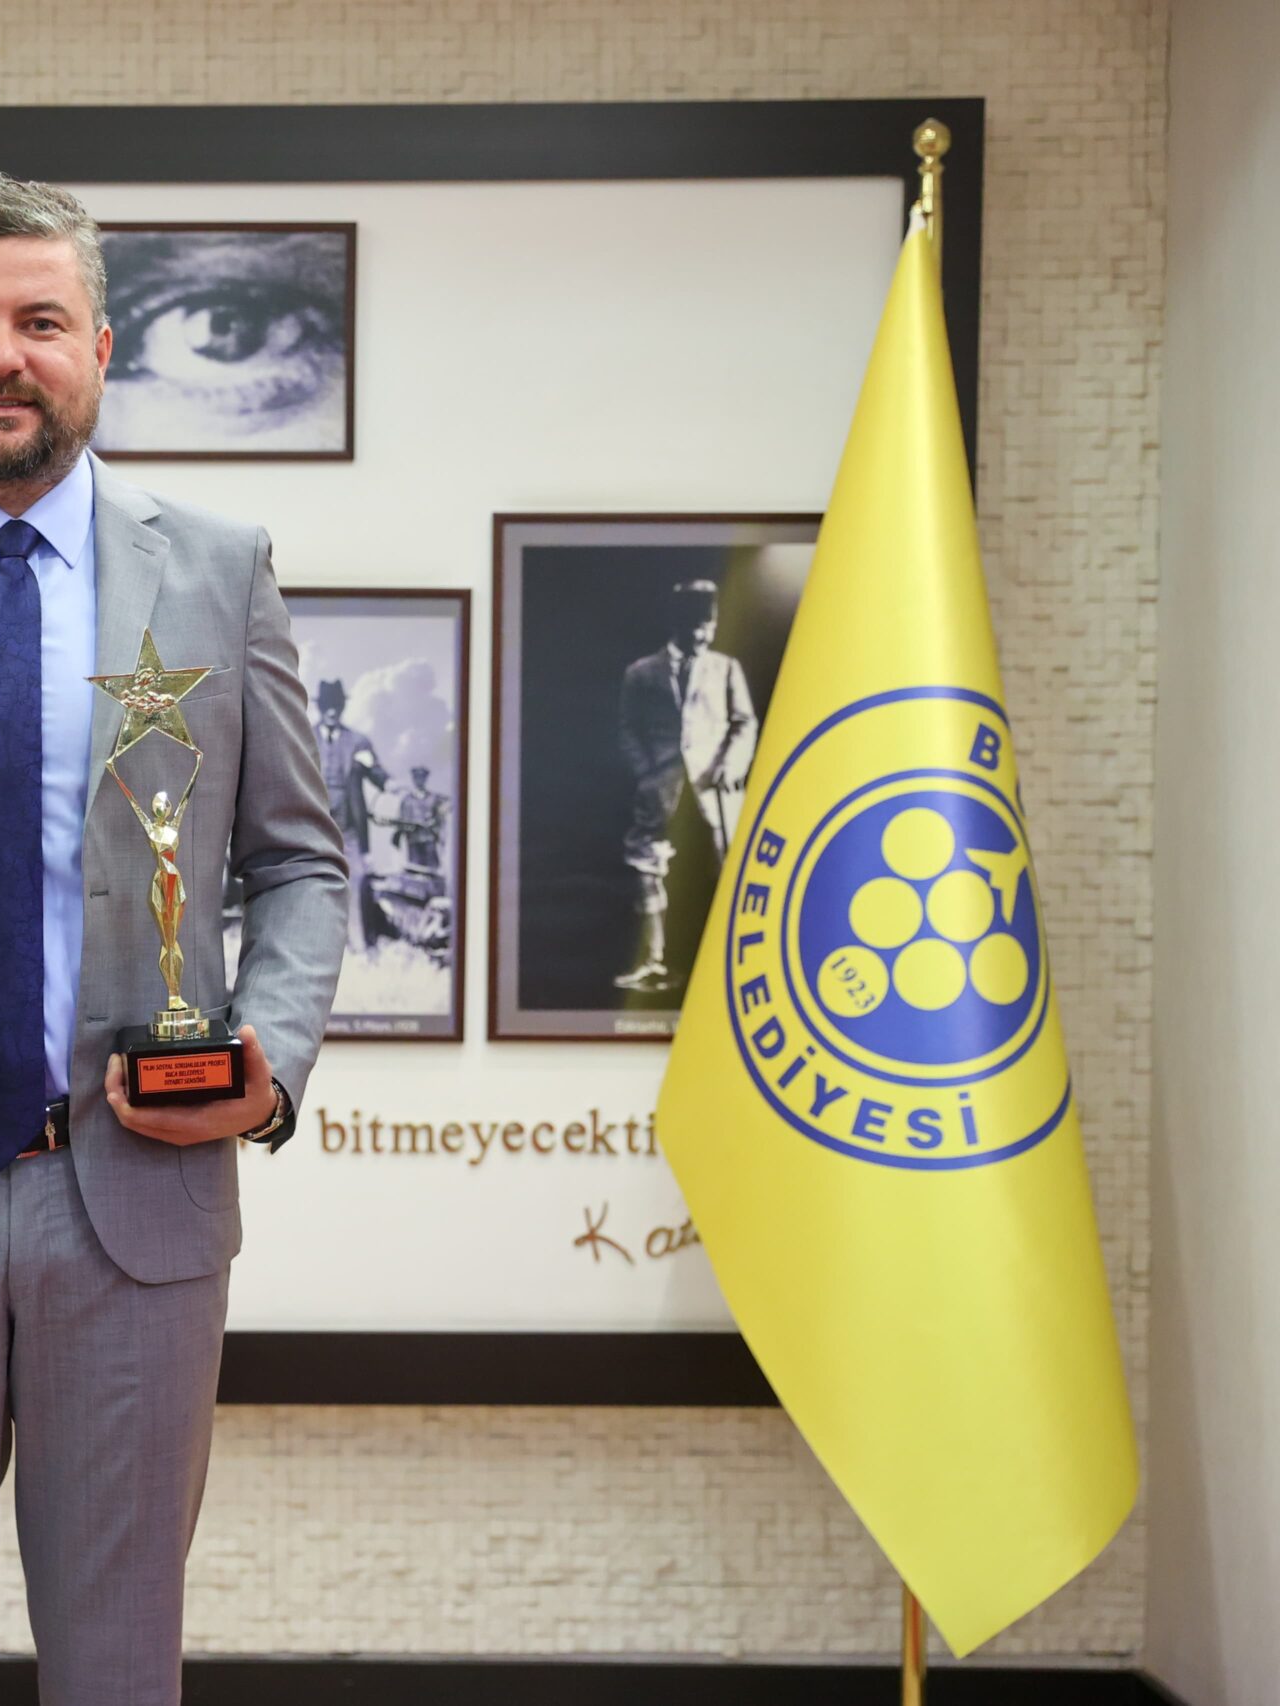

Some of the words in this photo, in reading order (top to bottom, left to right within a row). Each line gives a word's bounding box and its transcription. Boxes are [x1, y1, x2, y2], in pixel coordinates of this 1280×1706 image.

[737, 827, 979, 1151] BELEDİYESİ
[828, 955, 877, 1010] 1923
[316, 1107, 657, 1166] bitmeyecekti
